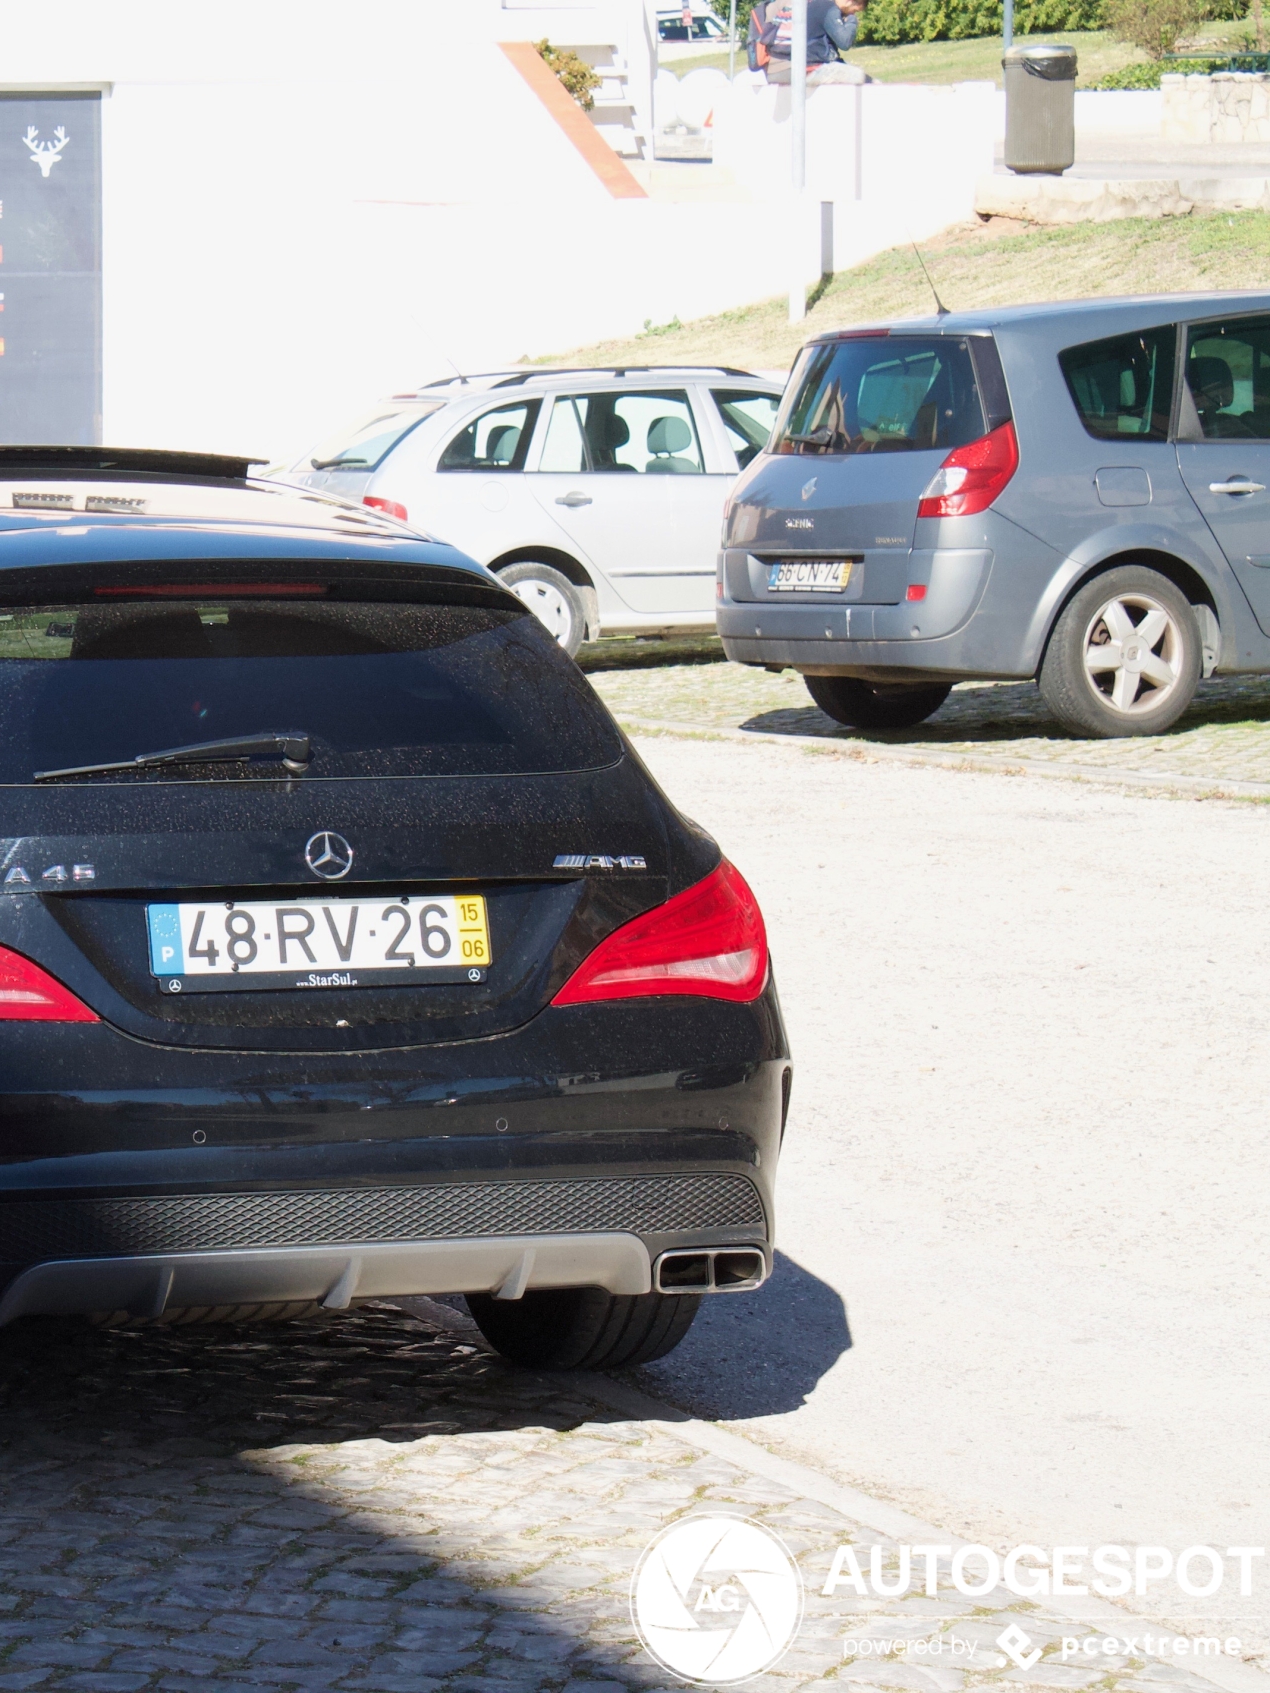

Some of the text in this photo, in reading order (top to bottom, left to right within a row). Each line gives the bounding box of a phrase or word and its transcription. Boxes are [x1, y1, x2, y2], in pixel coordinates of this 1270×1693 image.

[584, 855, 647, 868] AMG
[42, 864, 96, 884] 45
[460, 903, 478, 922] 15
[161, 946, 175, 963] P
[461, 940, 484, 958] 06
